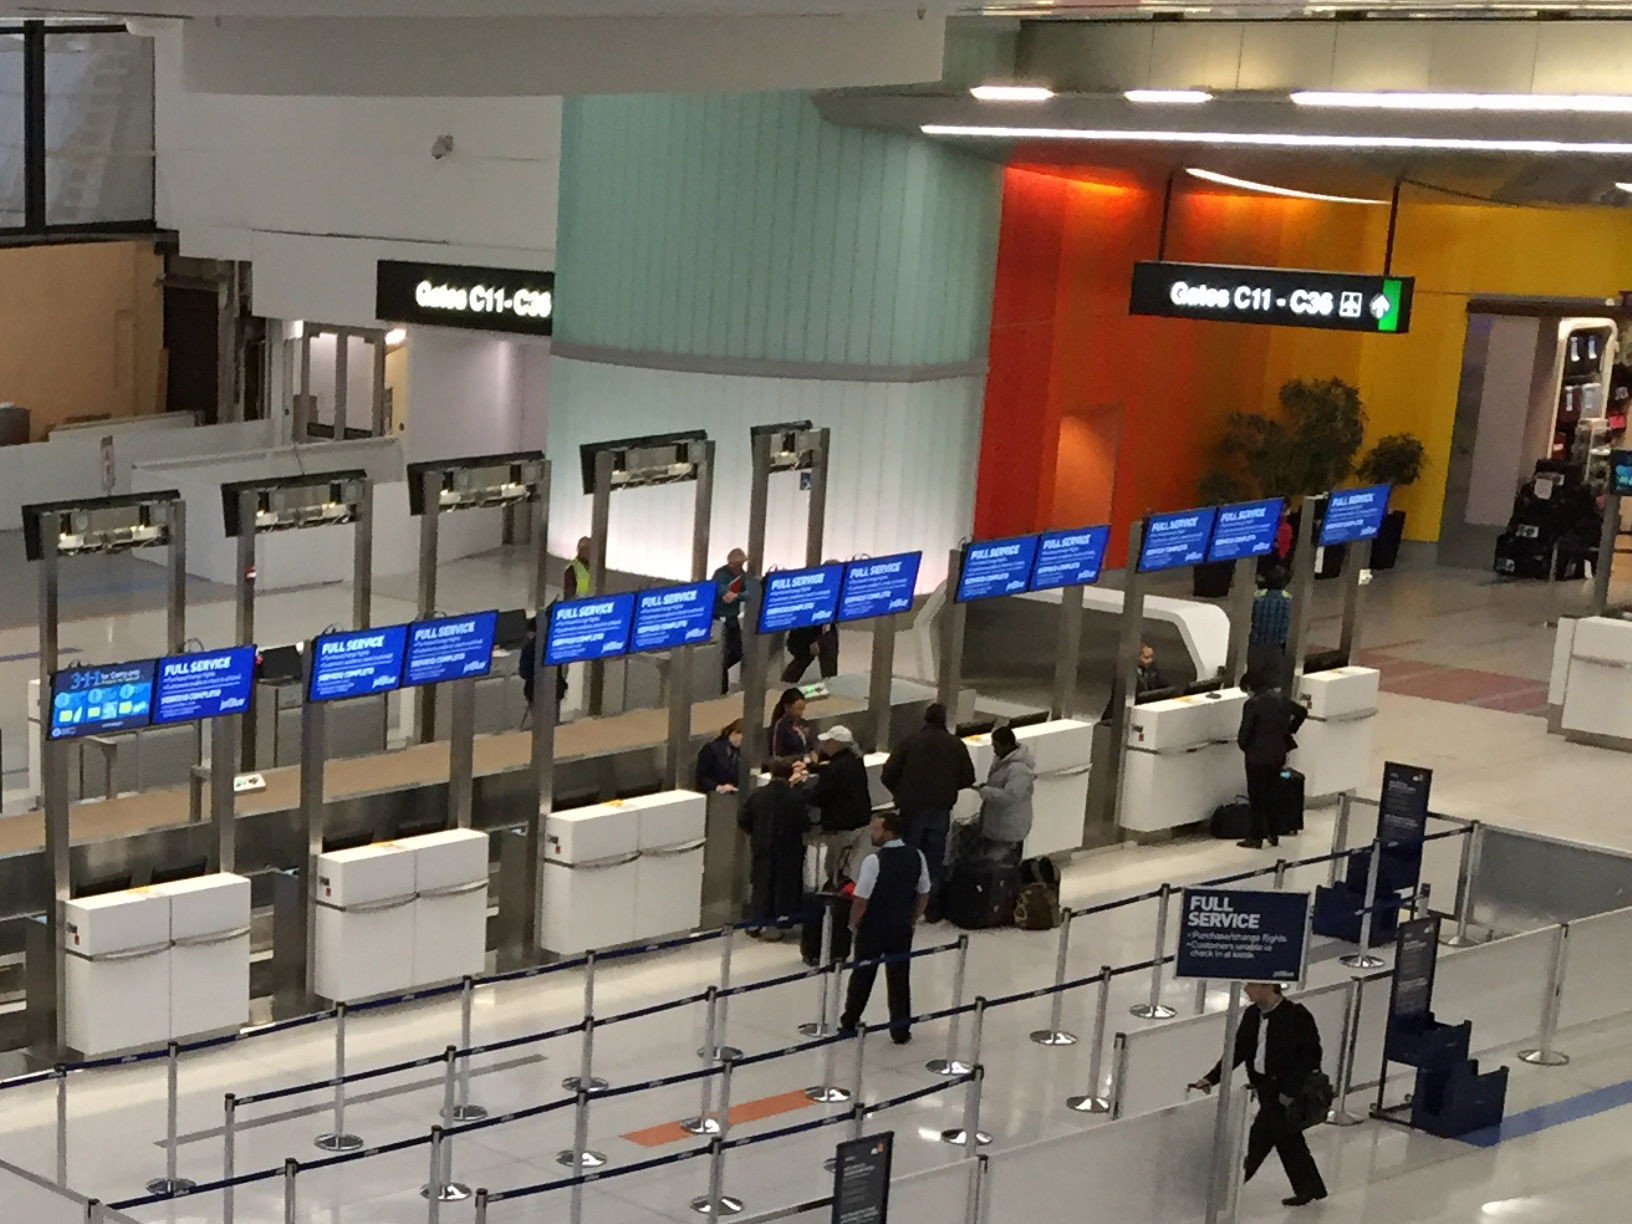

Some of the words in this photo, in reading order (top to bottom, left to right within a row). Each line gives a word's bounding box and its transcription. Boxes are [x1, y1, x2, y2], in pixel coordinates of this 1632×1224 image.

[415, 279, 467, 310] Gates
[1170, 281, 1229, 308] Gates
[1234, 286, 1271, 310] C11
[1290, 289, 1333, 315] C36
[1043, 540, 1060, 550] FULL
[1061, 534, 1091, 548] SERVICE
[971, 549, 989, 560] FULL
[989, 545, 1020, 558] SERVICE
[850, 568, 868, 579] FULL
[869, 561, 902, 576] SERVICE
[771, 578, 791, 590] FULL
[792, 573, 825, 587] SERVICE
[641, 597, 662, 608] FULL
[663, 590, 698, 605] SERVICE
[556, 609, 578, 620] FULL
[579, 602, 615, 617] SERVICE
[415, 629, 437, 641] FULL
[438, 622, 475, 639] SERVICE
[322, 643, 343, 654] FULL
[346, 635, 385, 652] SERVICE
[164, 663, 189, 677] FULL
[190, 656, 231, 673] SERVICE
[1190, 896, 1233, 912] FULL
[1188, 911, 1261, 929] SERVICE
